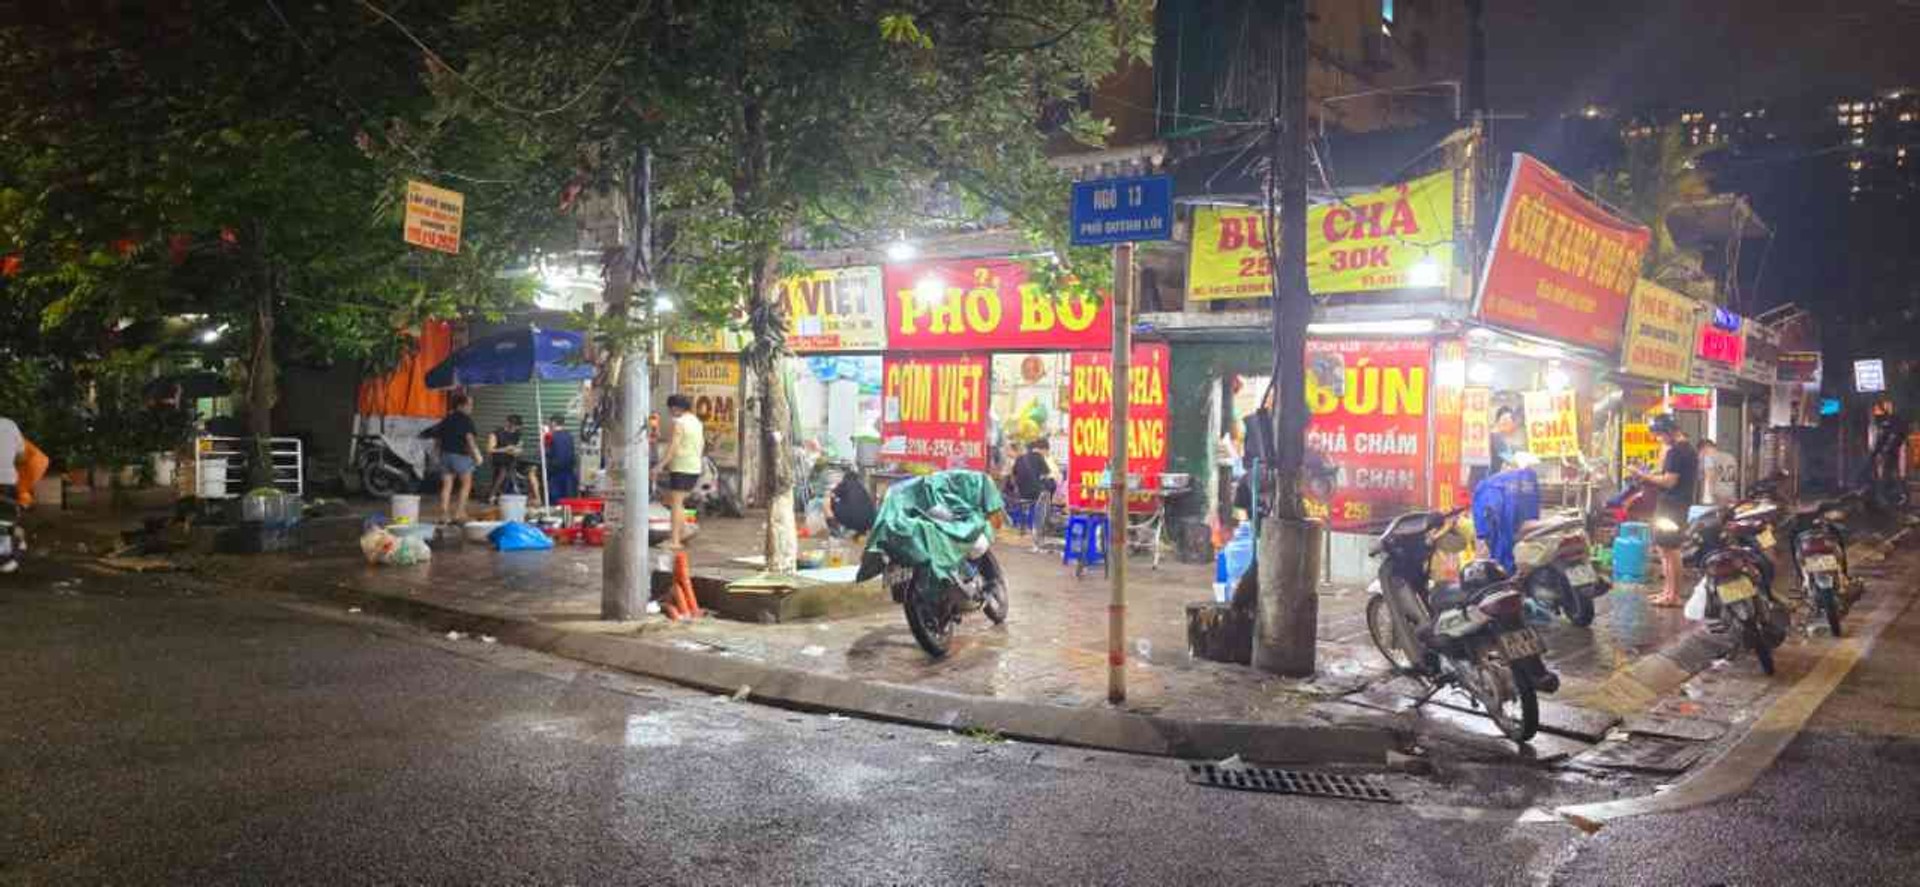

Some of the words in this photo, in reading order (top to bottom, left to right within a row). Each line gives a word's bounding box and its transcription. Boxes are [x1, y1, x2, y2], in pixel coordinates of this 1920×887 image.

[1322, 183, 1419, 243] CHẢ
[1328, 246, 1390, 273] 30K
[1127, 350, 1163, 405] HẢ
